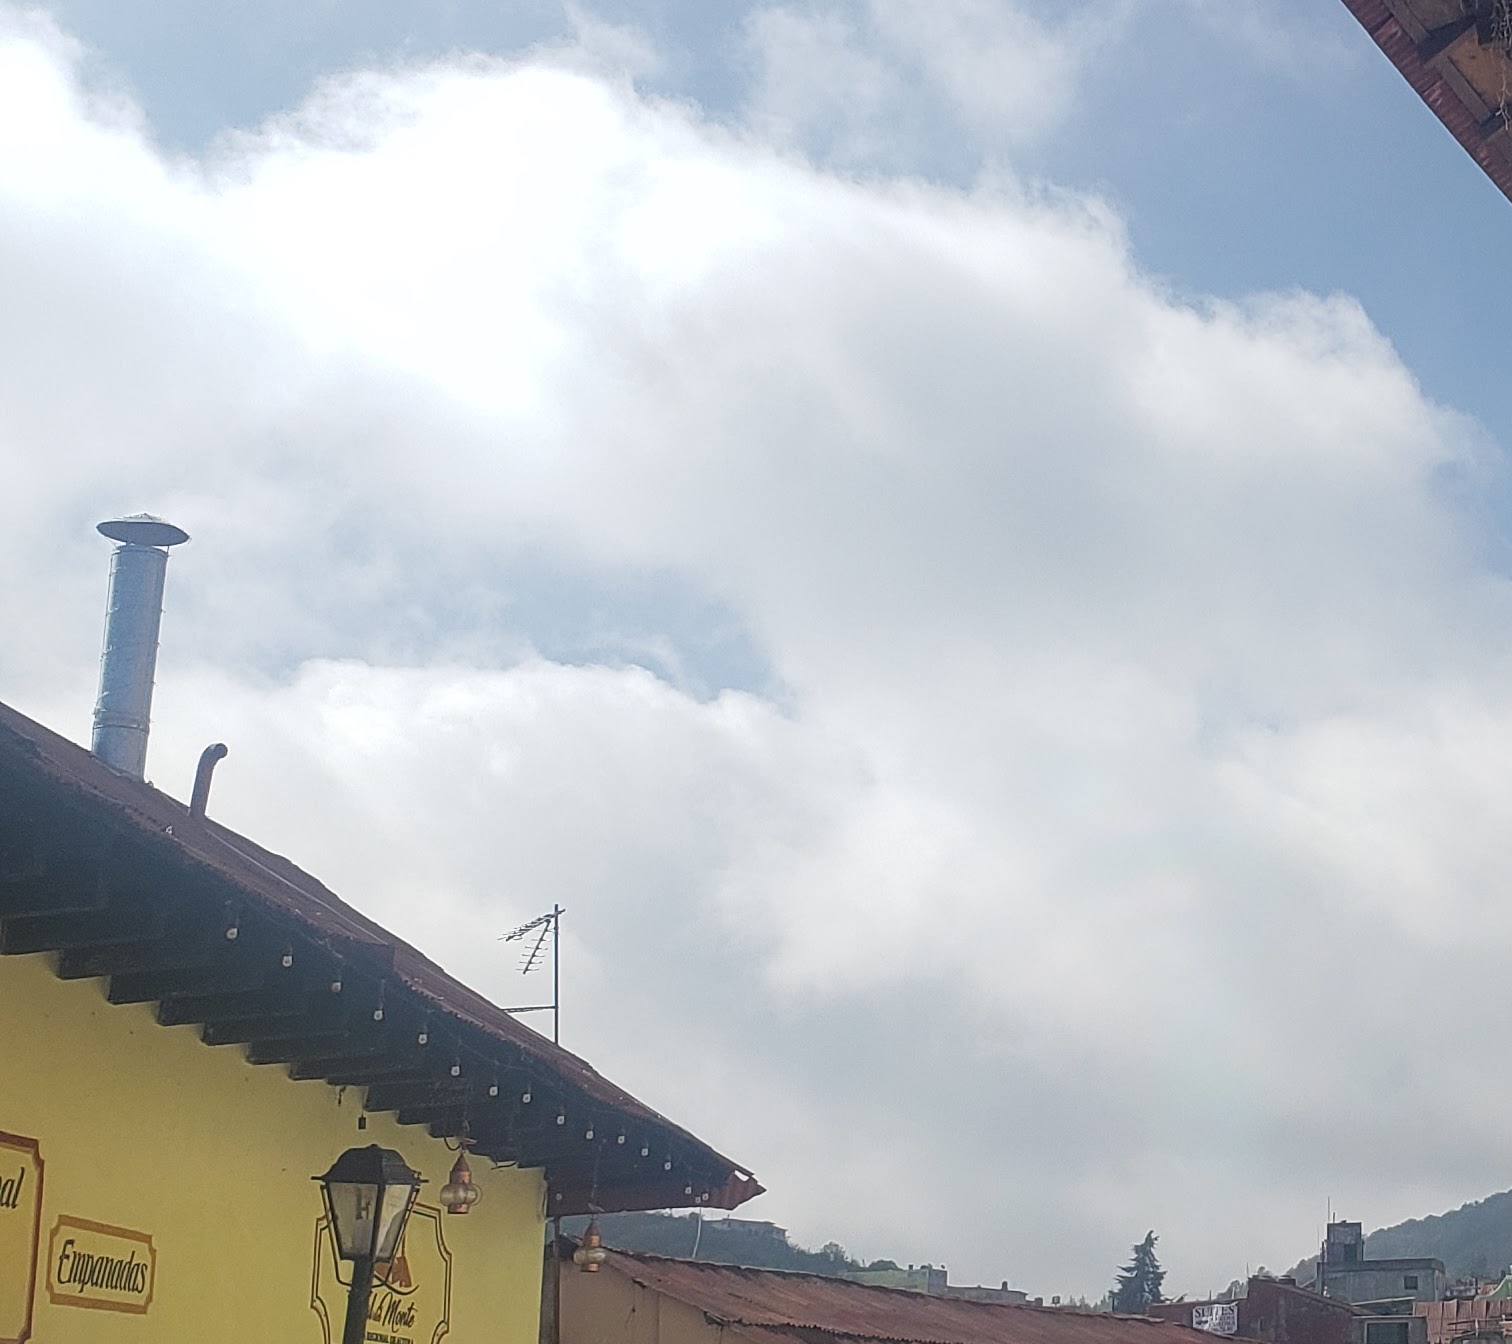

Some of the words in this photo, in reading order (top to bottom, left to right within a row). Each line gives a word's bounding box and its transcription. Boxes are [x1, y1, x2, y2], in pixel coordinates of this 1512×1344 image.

[0, 1166, 25, 1210] al
[57, 1238, 149, 1294] Empanadas
[382, 1291, 418, 1333] Monte
